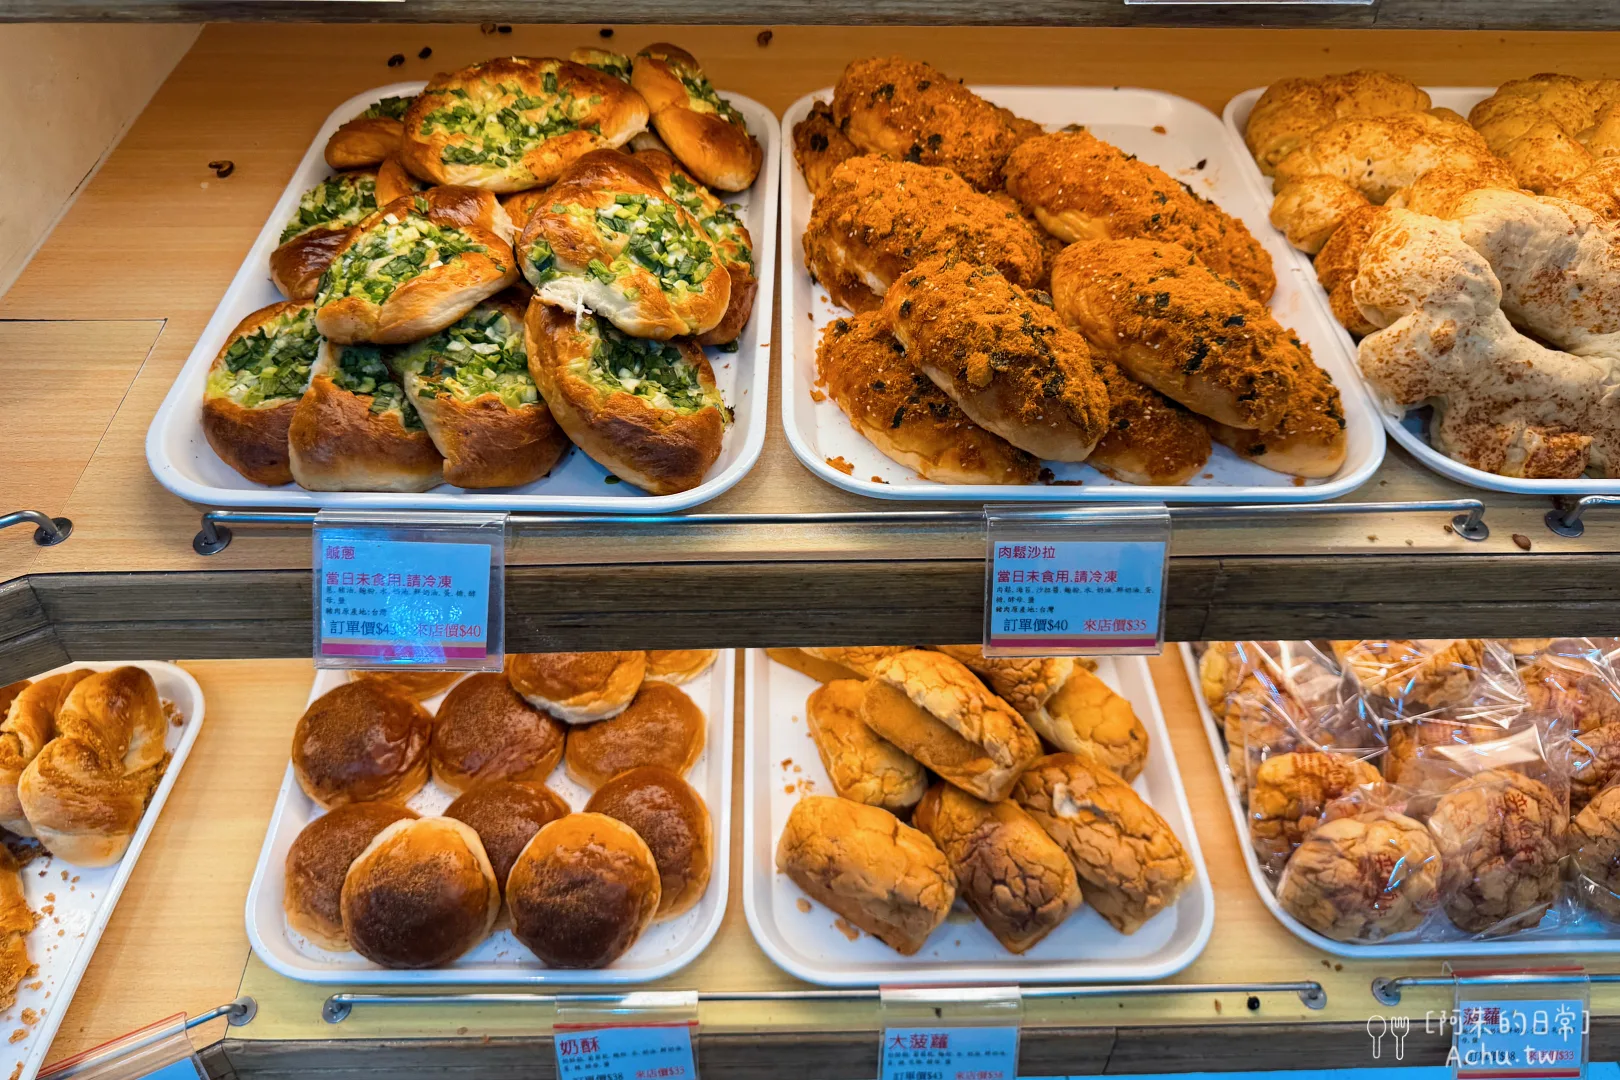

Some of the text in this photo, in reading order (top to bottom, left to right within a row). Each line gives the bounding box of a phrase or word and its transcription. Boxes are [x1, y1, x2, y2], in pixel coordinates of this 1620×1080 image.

[998, 545, 1057, 559] 肉鬆沙拉
[1003, 618, 1069, 632] 訂單價$40
[1083, 618, 1148, 632] 來店價$35
[559, 1036, 601, 1056] 奶酥
[888, 1033, 950, 1050] 大菠蘿
